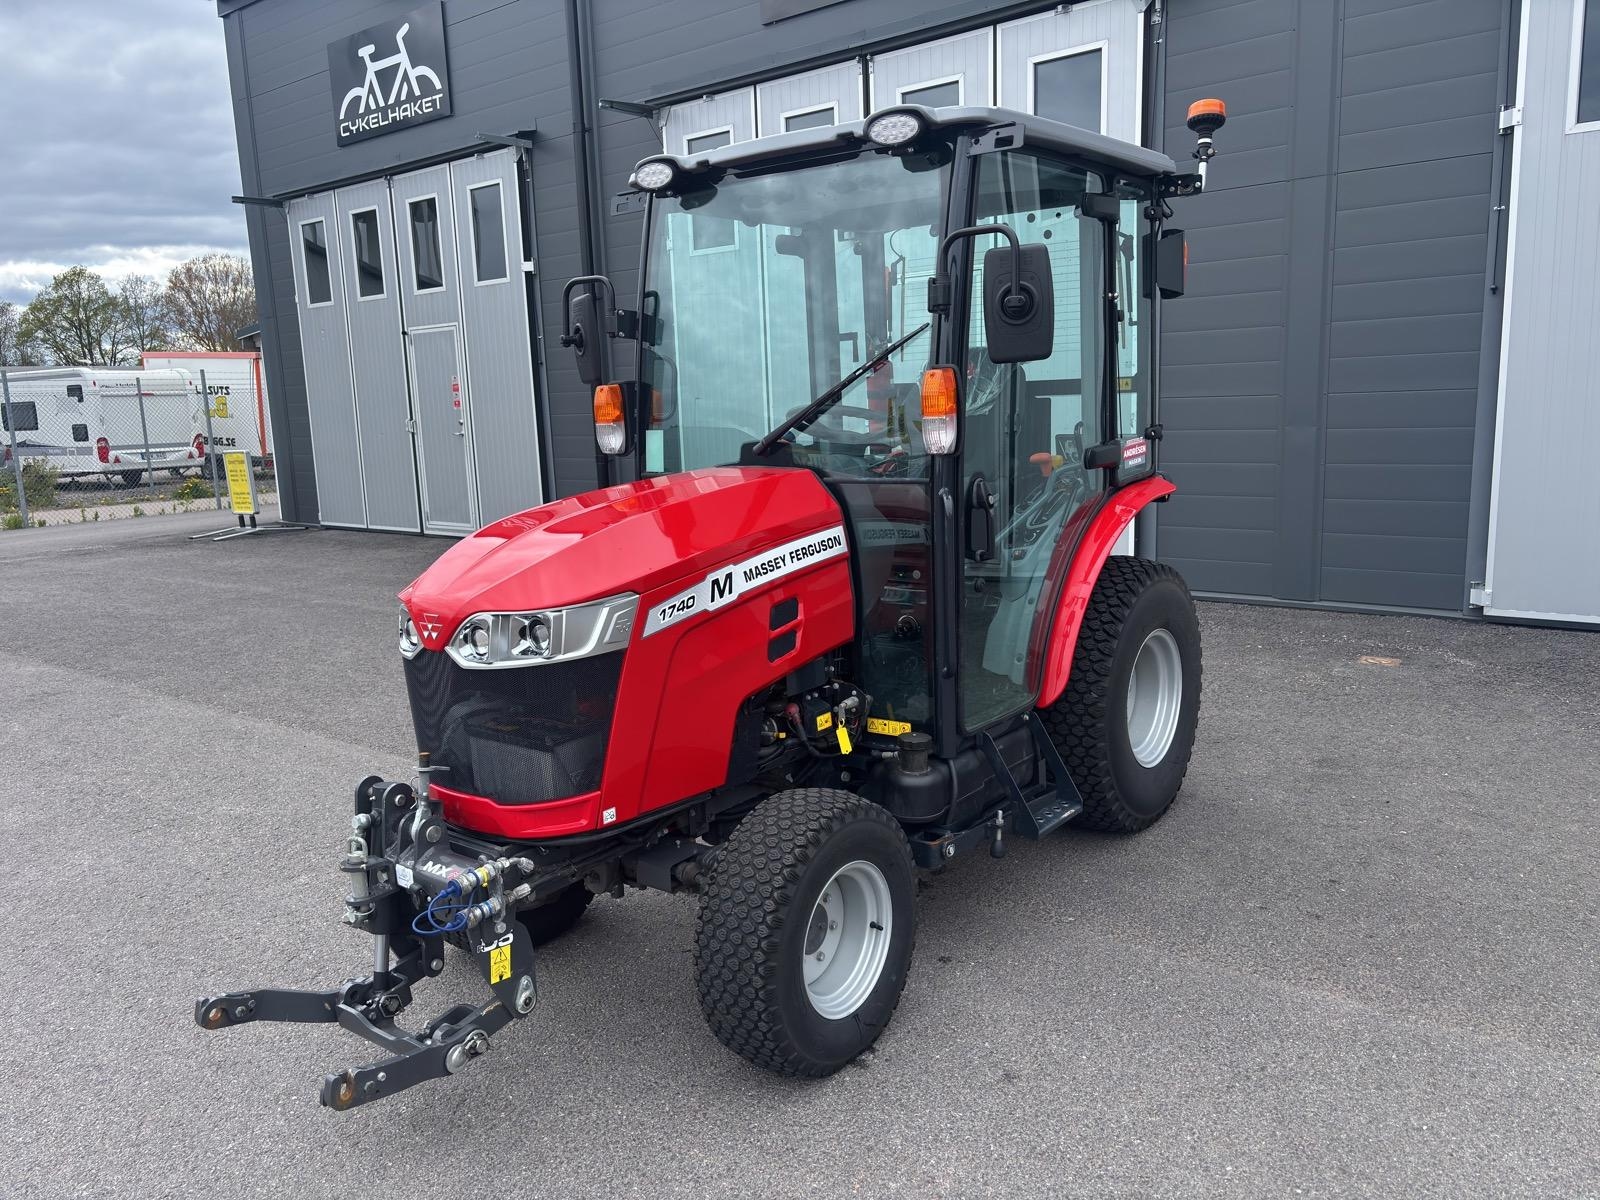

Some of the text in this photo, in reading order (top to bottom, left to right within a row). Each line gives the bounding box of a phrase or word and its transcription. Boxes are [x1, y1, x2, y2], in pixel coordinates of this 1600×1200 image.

[340, 94, 443, 137] CYKELHAKET
[195, 385, 230, 396] LSUTS
[203, 437, 236, 447] BGG.SE
[659, 534, 842, 621] 1740 M MASSEY FERGUSON
[422, 860, 453, 878] MX
